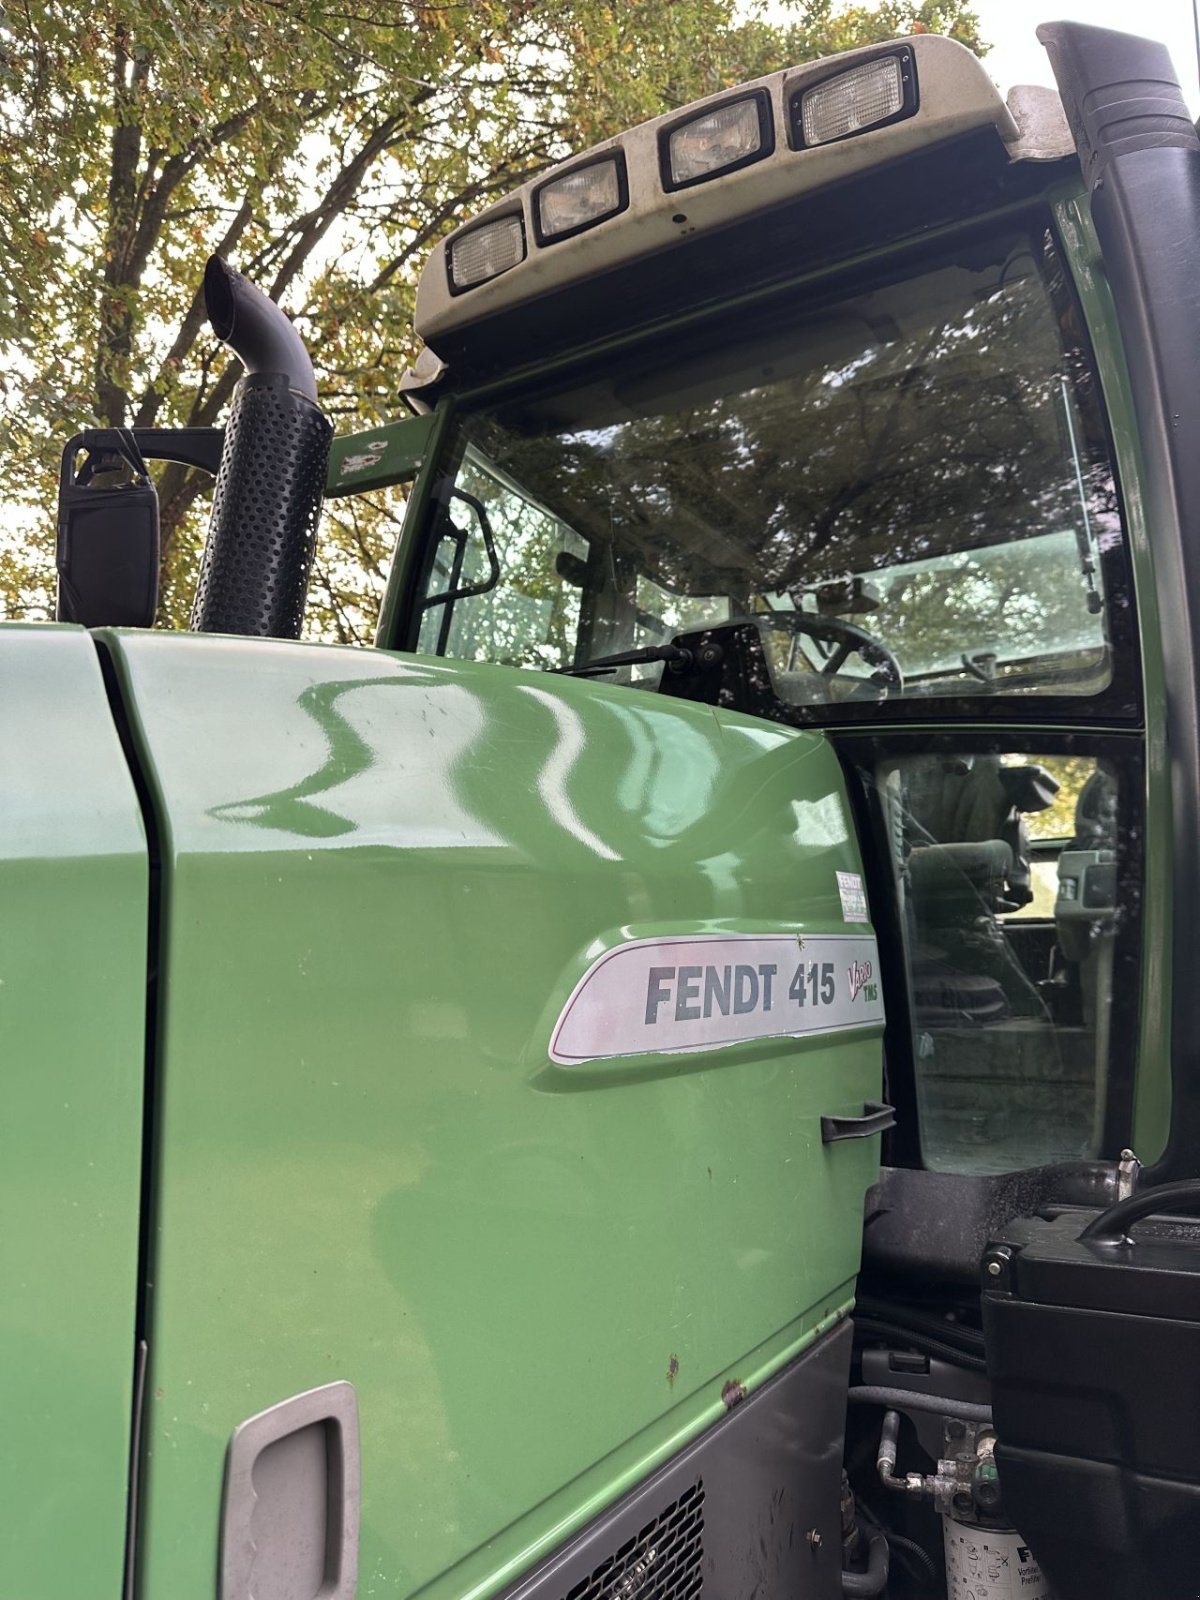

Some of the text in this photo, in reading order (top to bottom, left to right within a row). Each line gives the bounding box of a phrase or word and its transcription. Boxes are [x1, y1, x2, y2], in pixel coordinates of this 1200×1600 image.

[644, 963, 834, 1025] FENDT 415
[863, 983, 878, 1002] TMS
